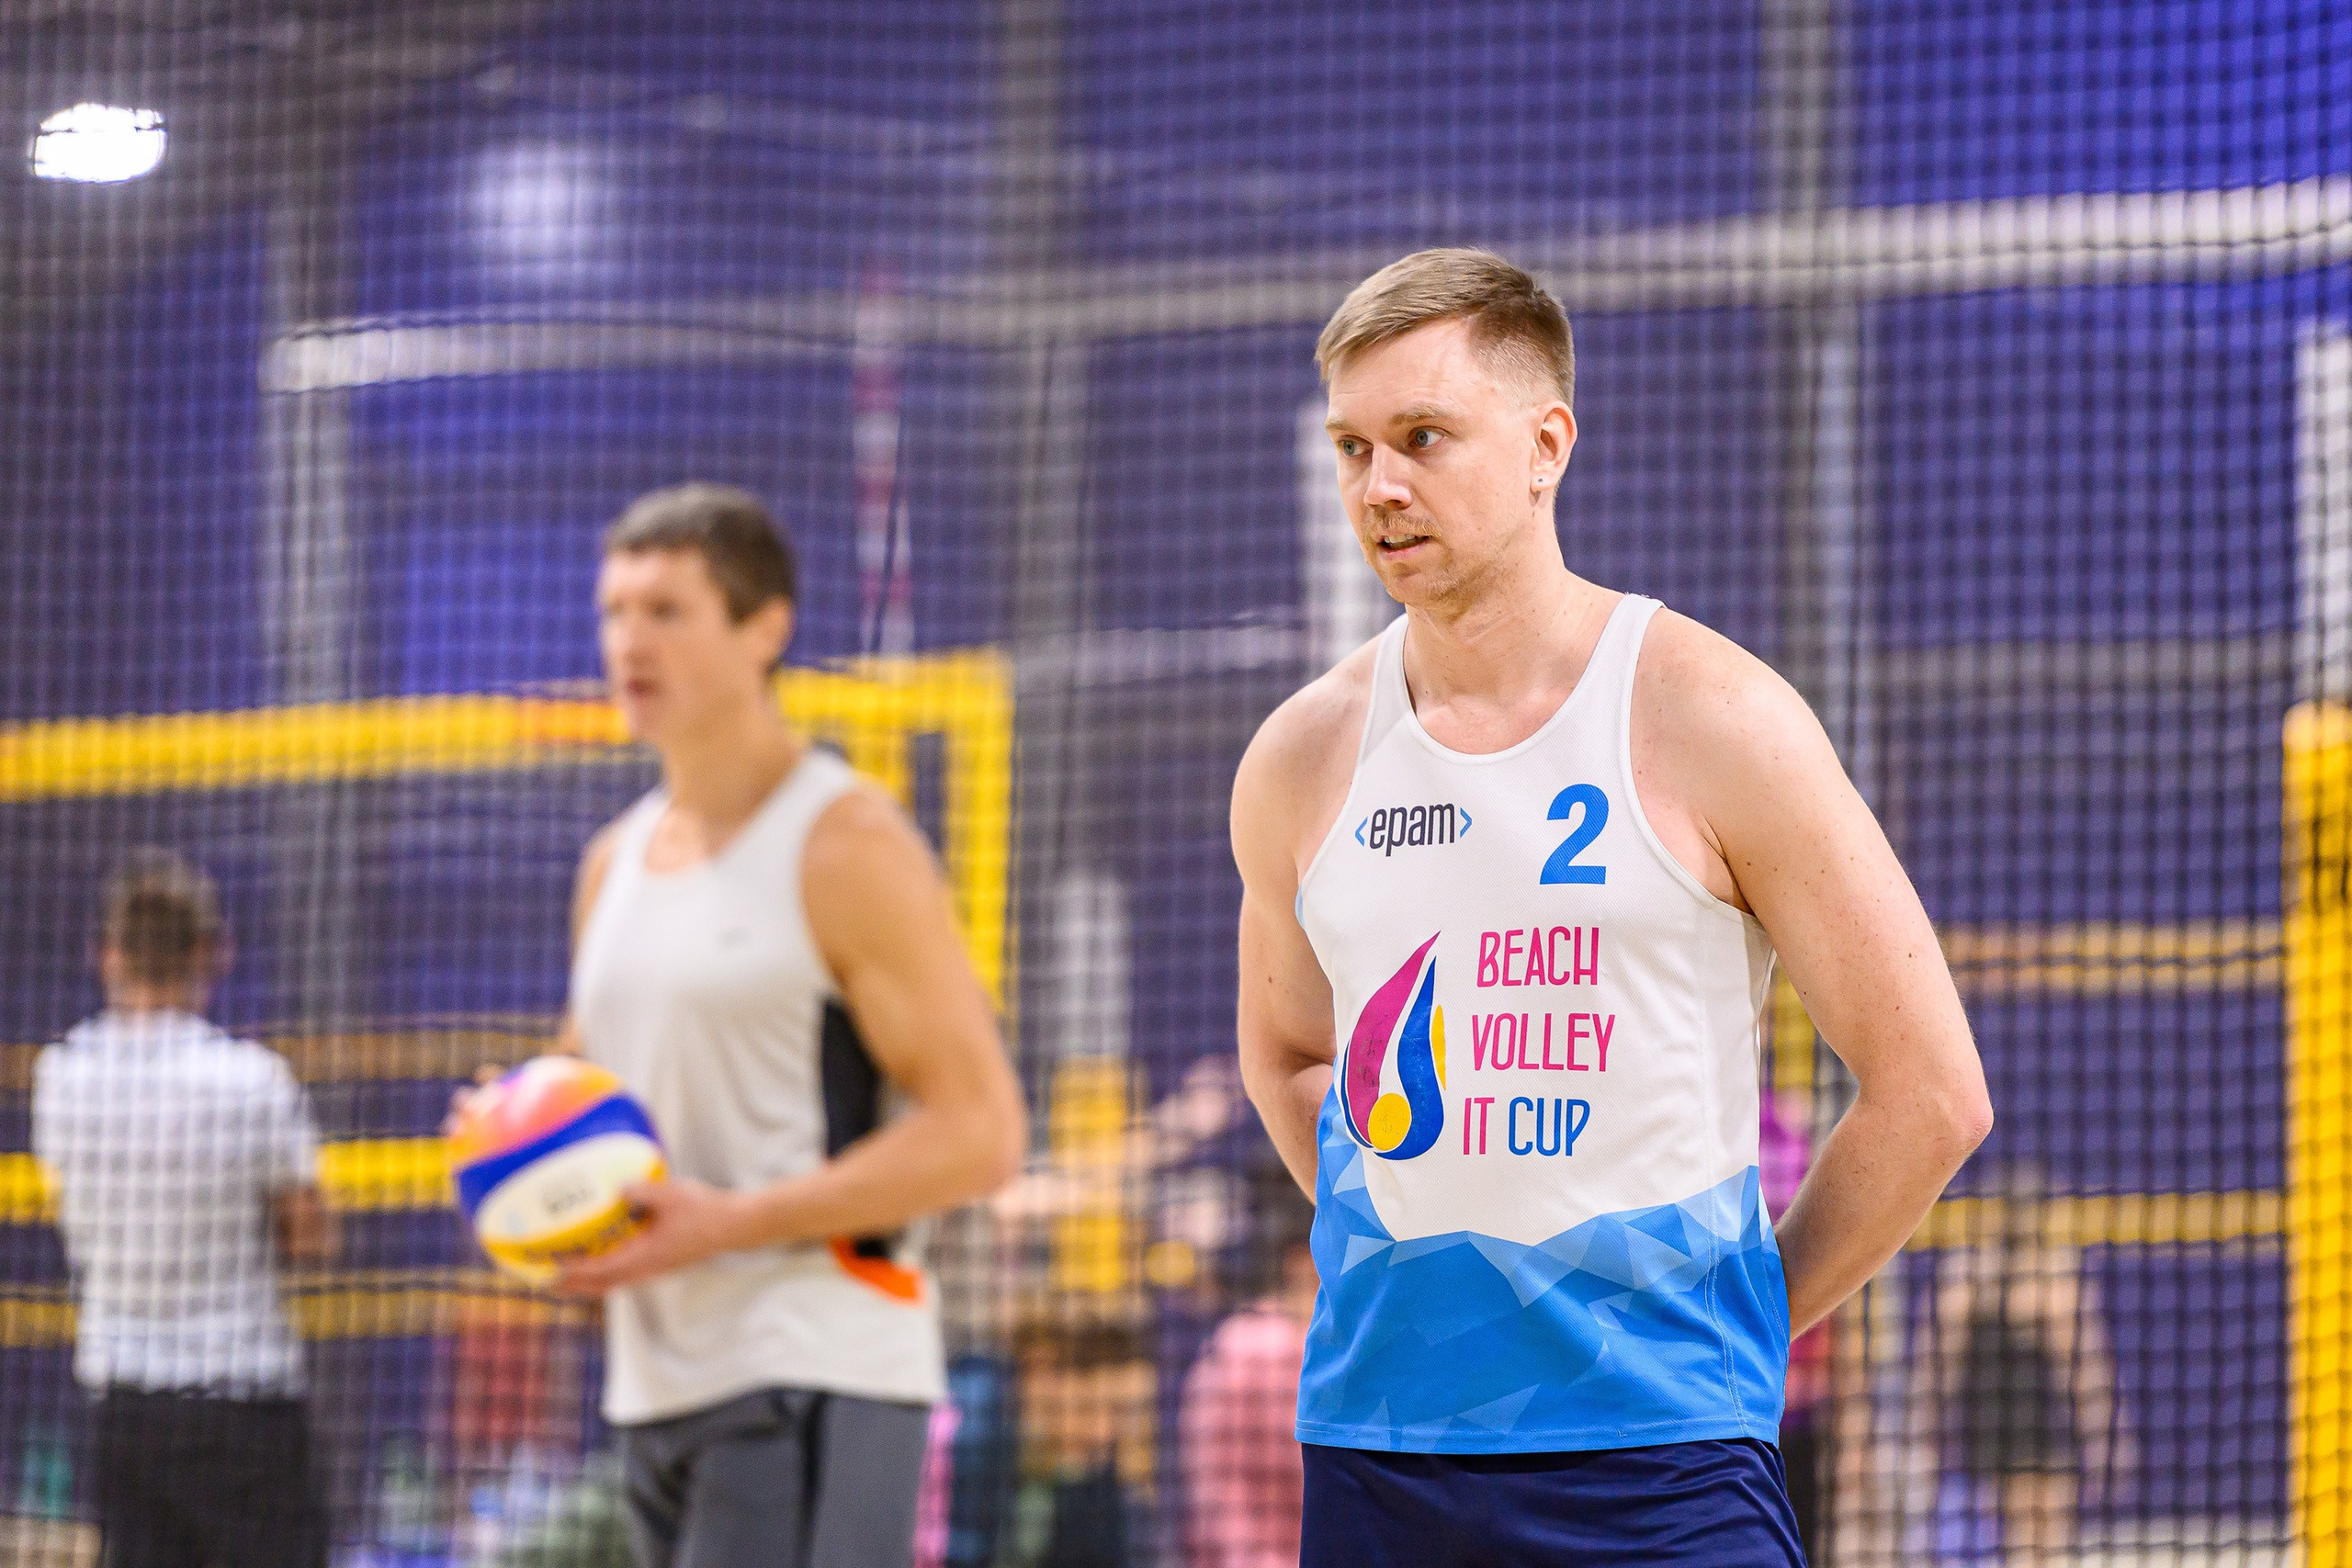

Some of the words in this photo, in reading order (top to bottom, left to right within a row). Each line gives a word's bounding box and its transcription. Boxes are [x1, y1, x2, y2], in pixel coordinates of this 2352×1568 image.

[1539, 783, 1610, 886] 2
[1476, 926, 1600, 987] BEACH
[1471, 1012, 1616, 1073] VOLLEY
[1463, 1097, 1496, 1156] IT
[1508, 1096, 1591, 1156] CUP
